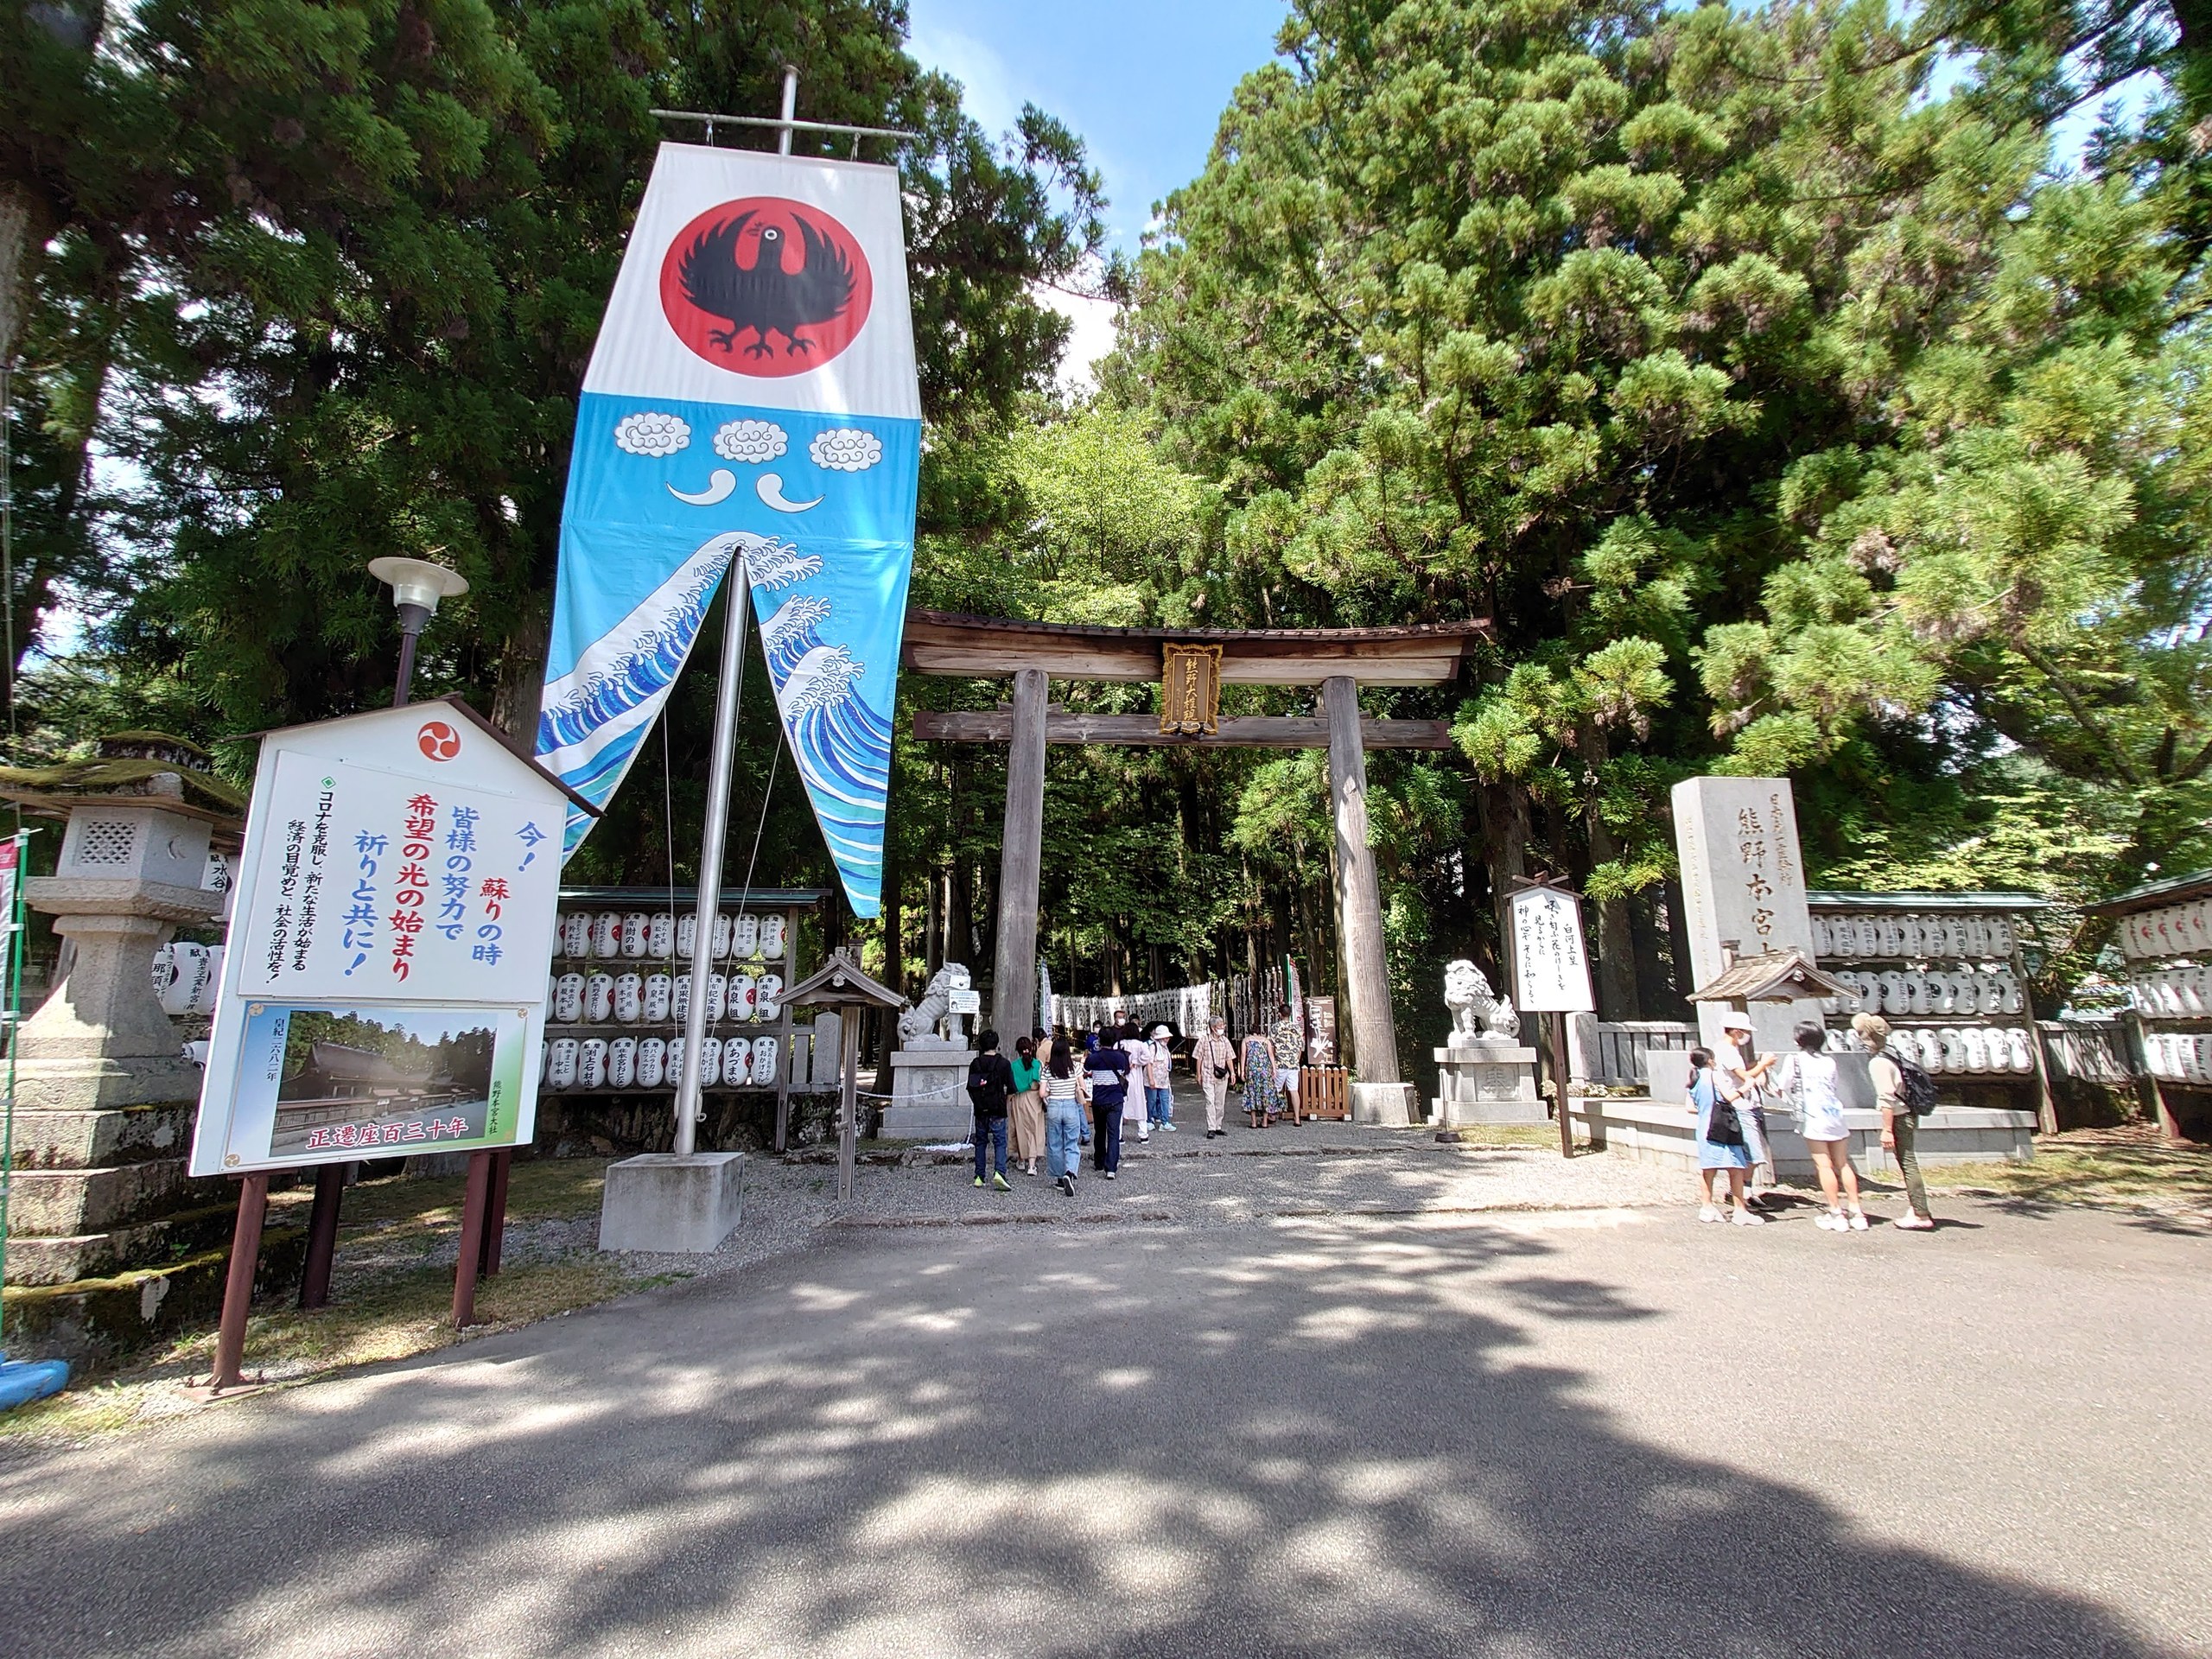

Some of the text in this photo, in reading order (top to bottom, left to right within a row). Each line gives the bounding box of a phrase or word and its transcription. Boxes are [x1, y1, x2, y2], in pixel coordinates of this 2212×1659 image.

[435, 805, 480, 941] 皆様の努力で
[515, 822, 548, 873] 今！
[342, 830, 390, 976] 祈りと共に！
[388, 792, 440, 983] 希望の光の始まり
[472, 877, 512, 966] 蘇りの時
[1563, 923, 1579, 966] 白河上皇
[267, 1018, 285, 1081] 皇紀二六八二年
[727, 1048, 741, 1084] あづまや
[305, 1116, 469, 1150] 正遷座百三十年
[488, 1080, 503, 1135] 熊野本宮大社
